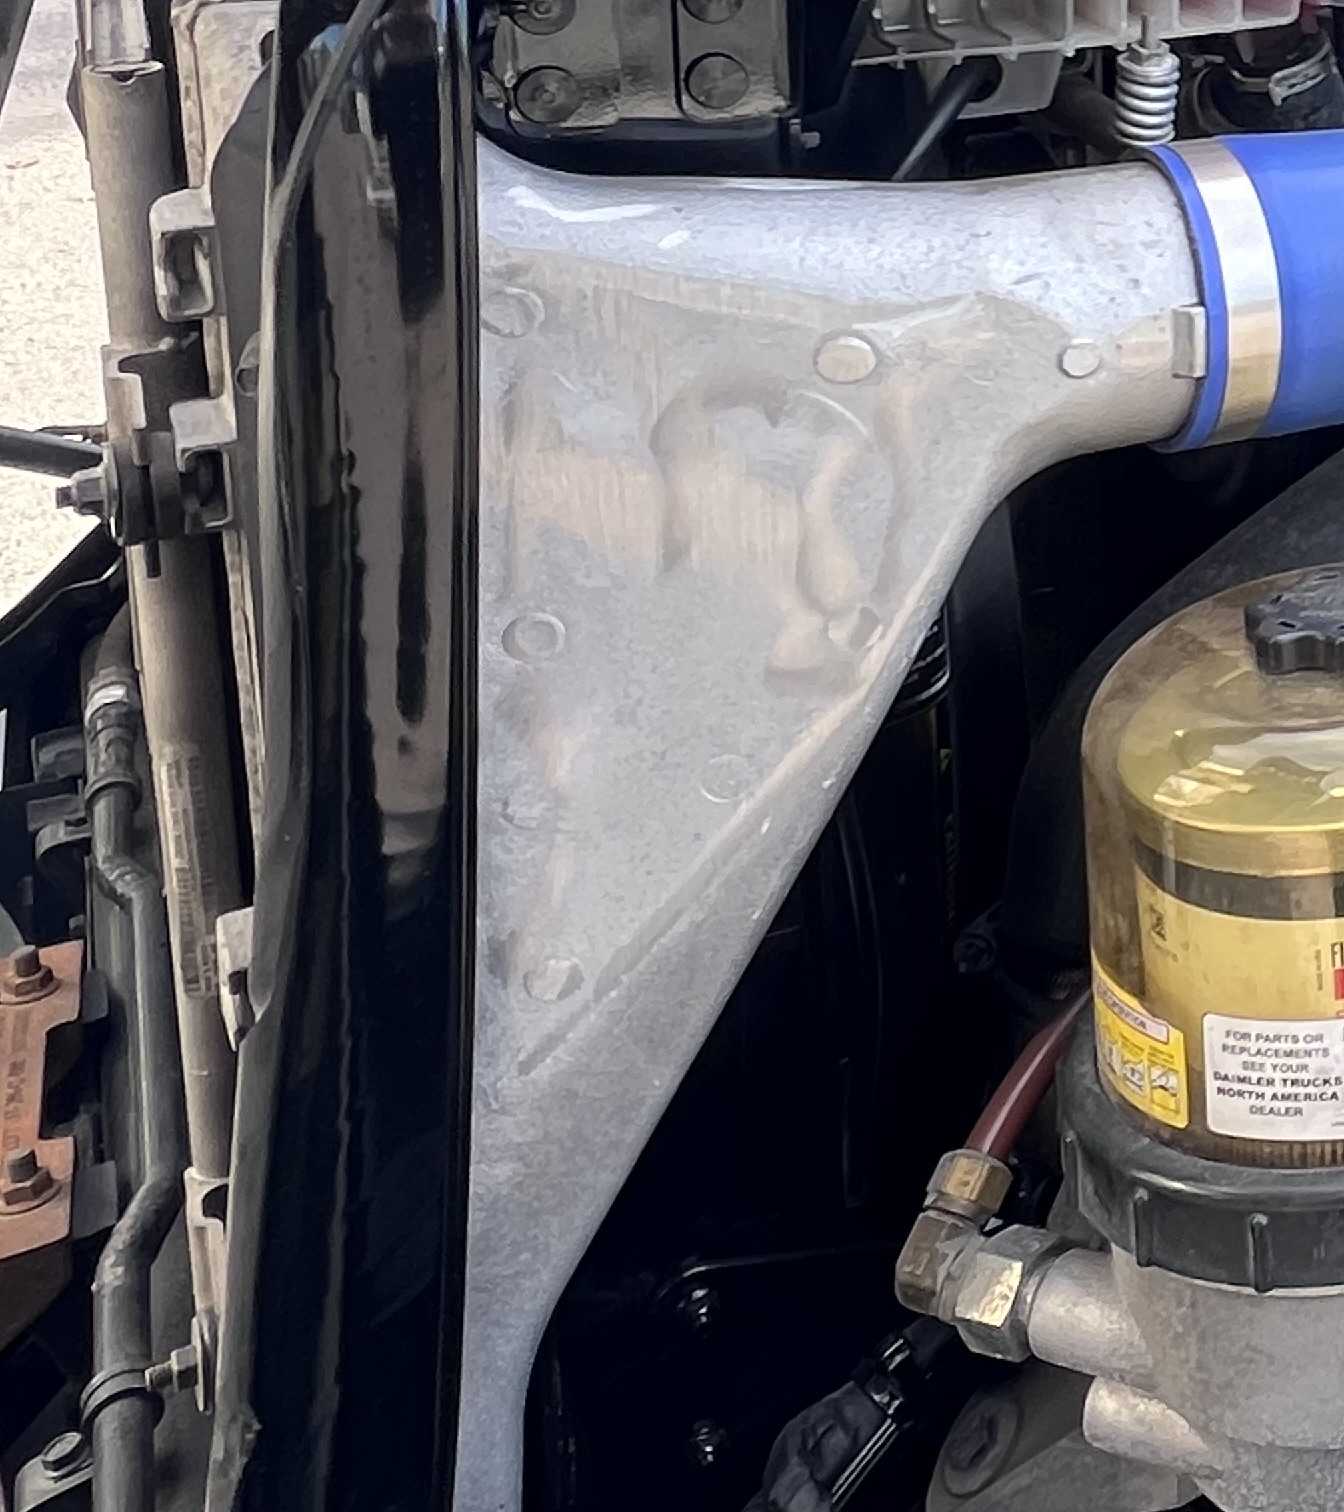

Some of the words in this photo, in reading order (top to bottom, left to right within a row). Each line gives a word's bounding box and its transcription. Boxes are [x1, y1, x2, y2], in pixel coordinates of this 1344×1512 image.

[1225, 1029, 1251, 1042] FOR
[1255, 1032, 1299, 1044] PARTS
[1303, 1032, 1324, 1044] OR
[1221, 1044, 1330, 1059] REPLACEMENTS
[1242, 1061, 1266, 1072] SEE
[1271, 1062, 1310, 1074] YOUR
[1213, 1071, 1276, 1087] DAIMLER
[1281, 1076, 1343, 1088] TRUCKS
[1216, 1086, 1265, 1101] NORTH
[1270, 1091, 1340, 1102] AMERICA
[1249, 1105, 1304, 1117] DEALER
